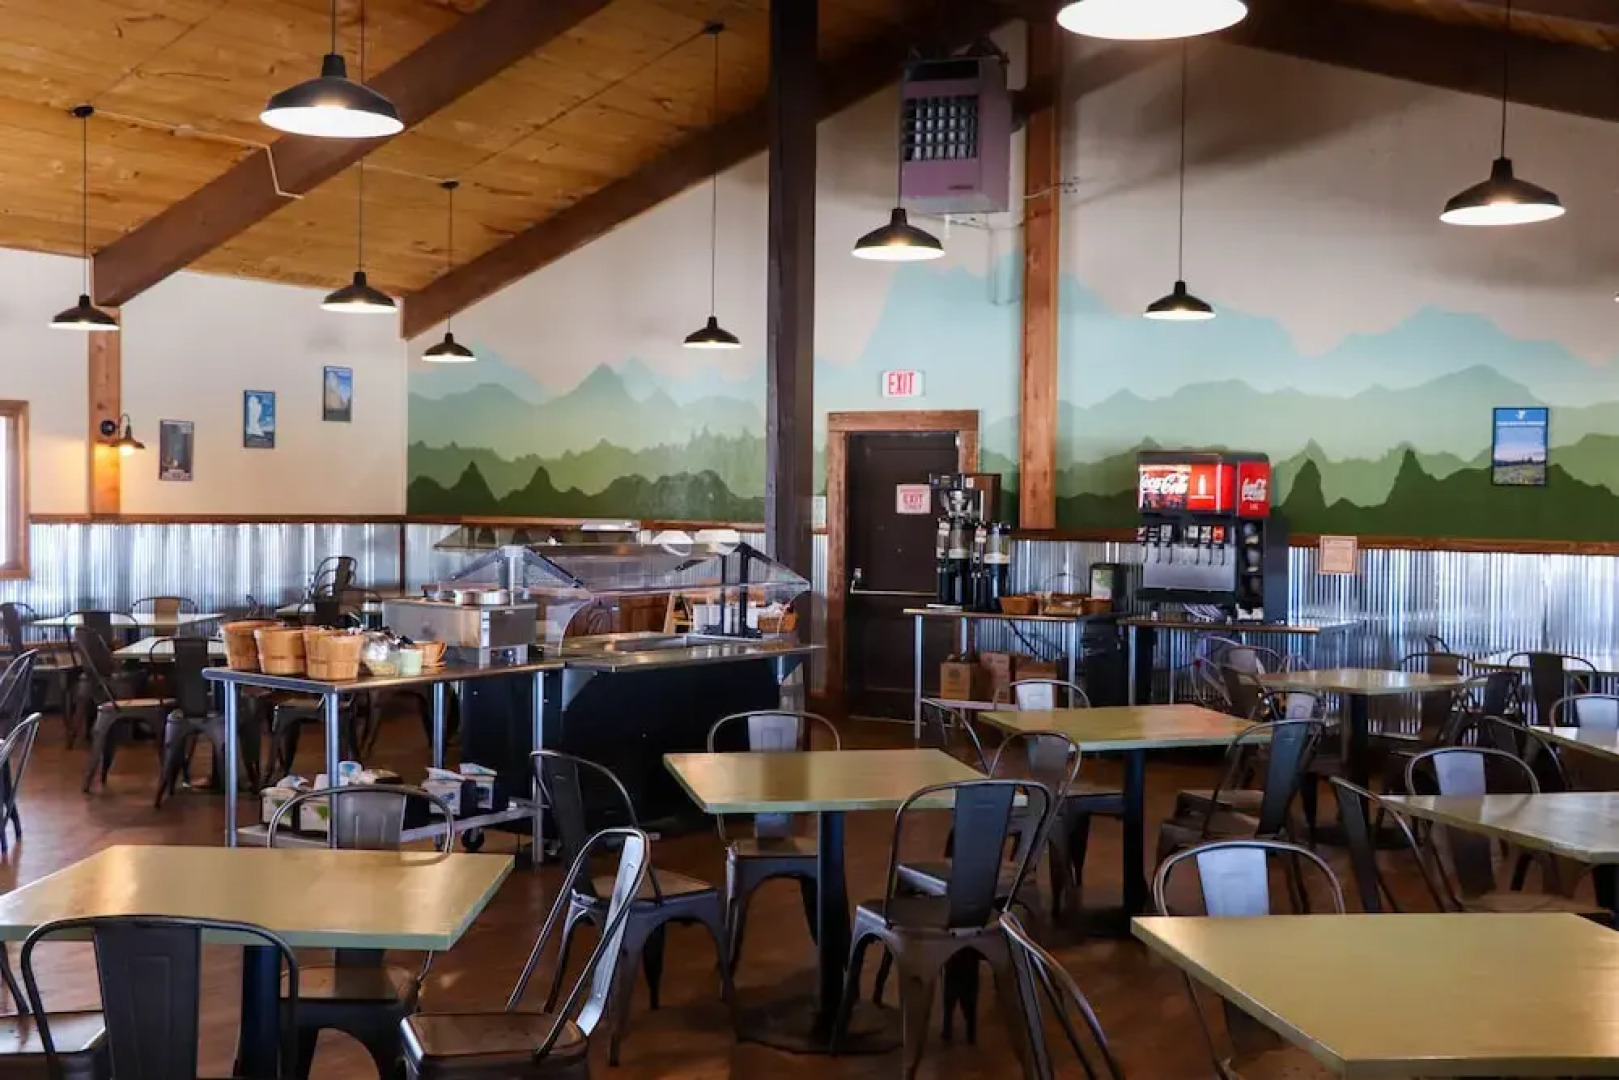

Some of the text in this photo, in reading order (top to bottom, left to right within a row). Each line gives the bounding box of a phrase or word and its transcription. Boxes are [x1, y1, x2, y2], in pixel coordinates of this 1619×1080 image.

[889, 372, 914, 395] EXIT
[1140, 473, 1190, 494] Coca-Cola
[903, 493, 923, 504] EXIT
